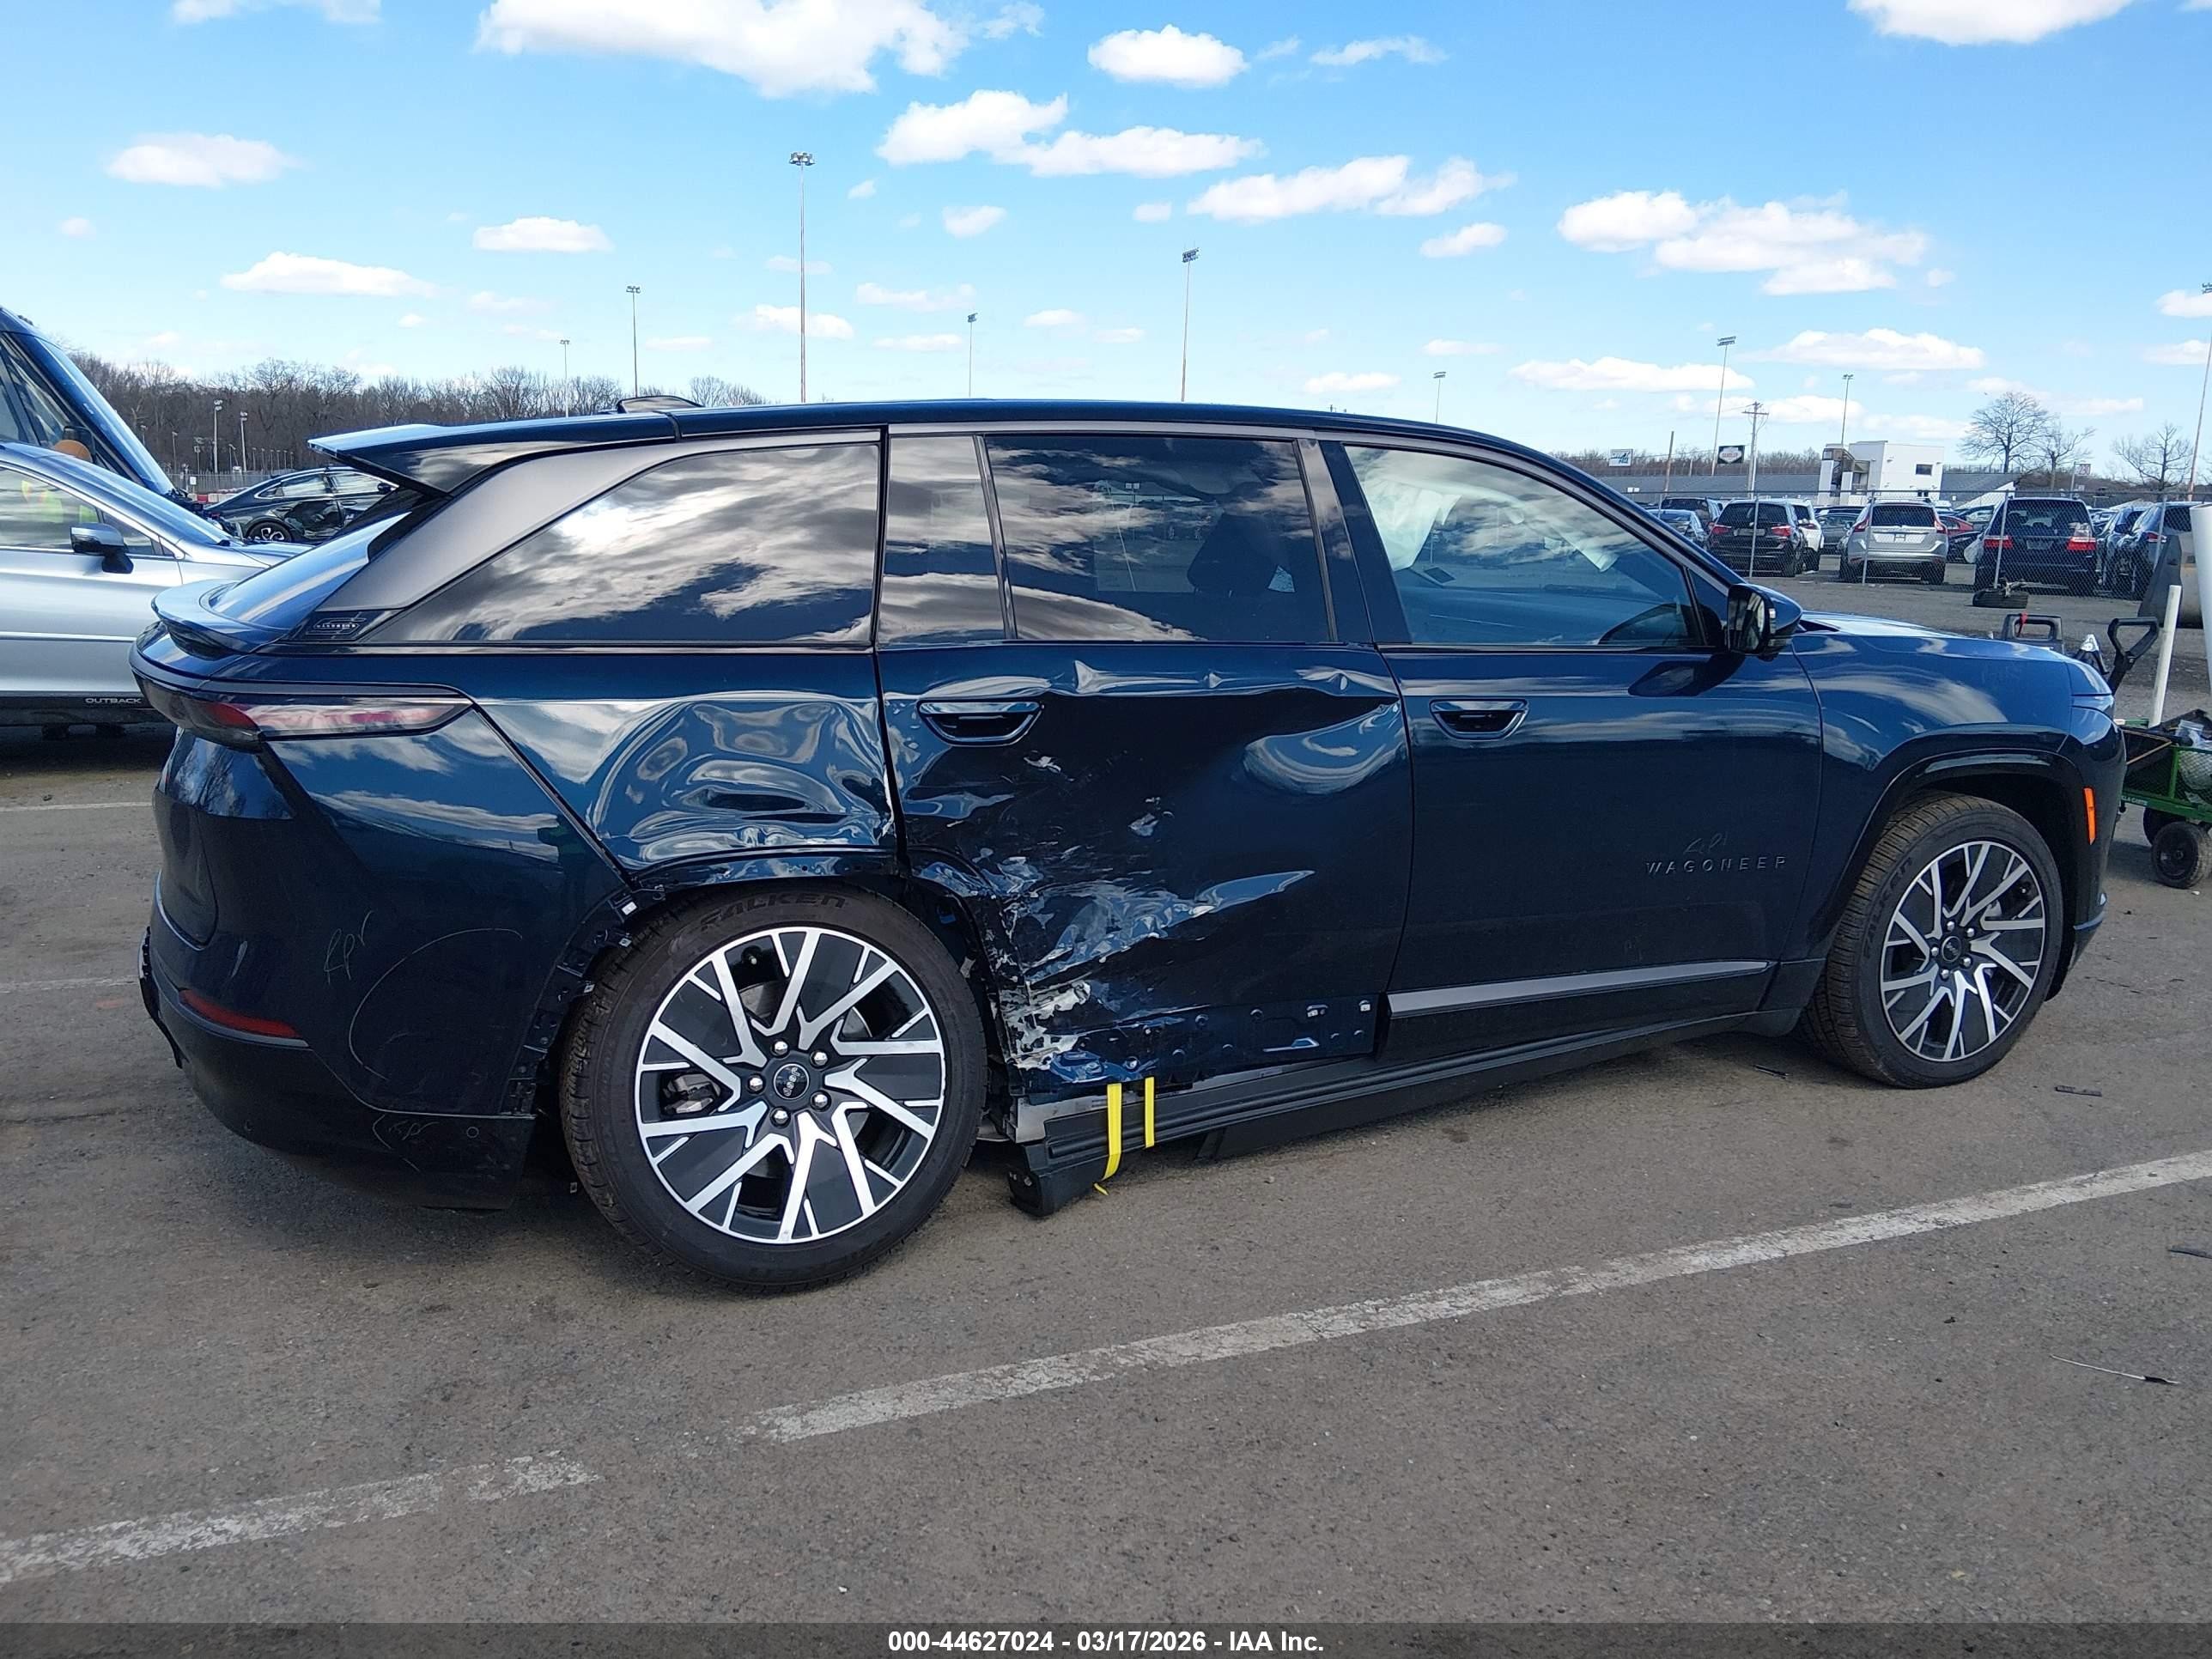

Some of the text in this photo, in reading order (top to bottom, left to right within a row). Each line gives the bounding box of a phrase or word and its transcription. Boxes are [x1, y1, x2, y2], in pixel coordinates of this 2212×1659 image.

[1645, 855, 1788, 875] WAGONEER
[699, 892, 847, 932] FALKEN
[782, 1066, 801, 1097] Jeep
